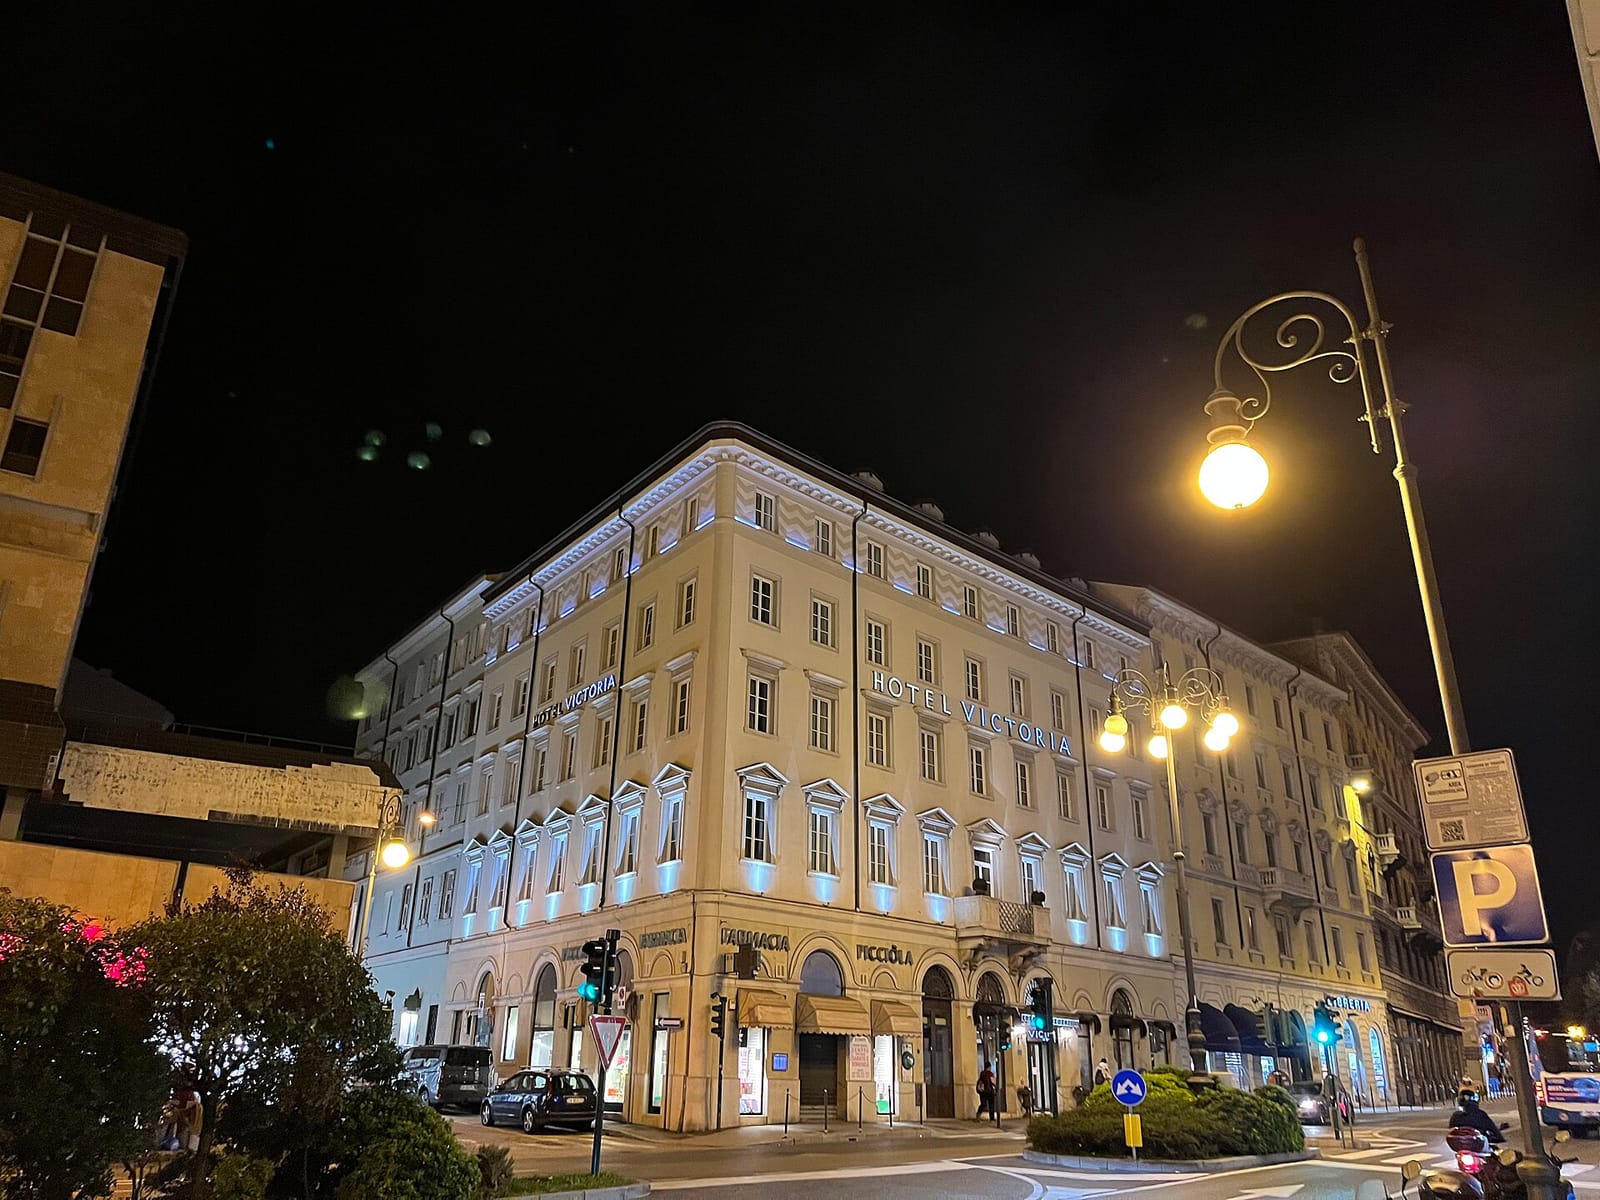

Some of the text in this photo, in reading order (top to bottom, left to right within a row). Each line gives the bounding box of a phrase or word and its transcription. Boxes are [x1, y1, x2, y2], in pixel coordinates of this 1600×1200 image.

[532, 673, 617, 728] HOTEL VICTORIA
[871, 670, 1072, 756] HOTEL VICTORIA
[1452, 859, 1517, 936] P
[639, 928, 687, 949] FARMACIA
[721, 927, 790, 952] FARMACIA
[1327, 996, 1371, 1012] LIBRERIA
